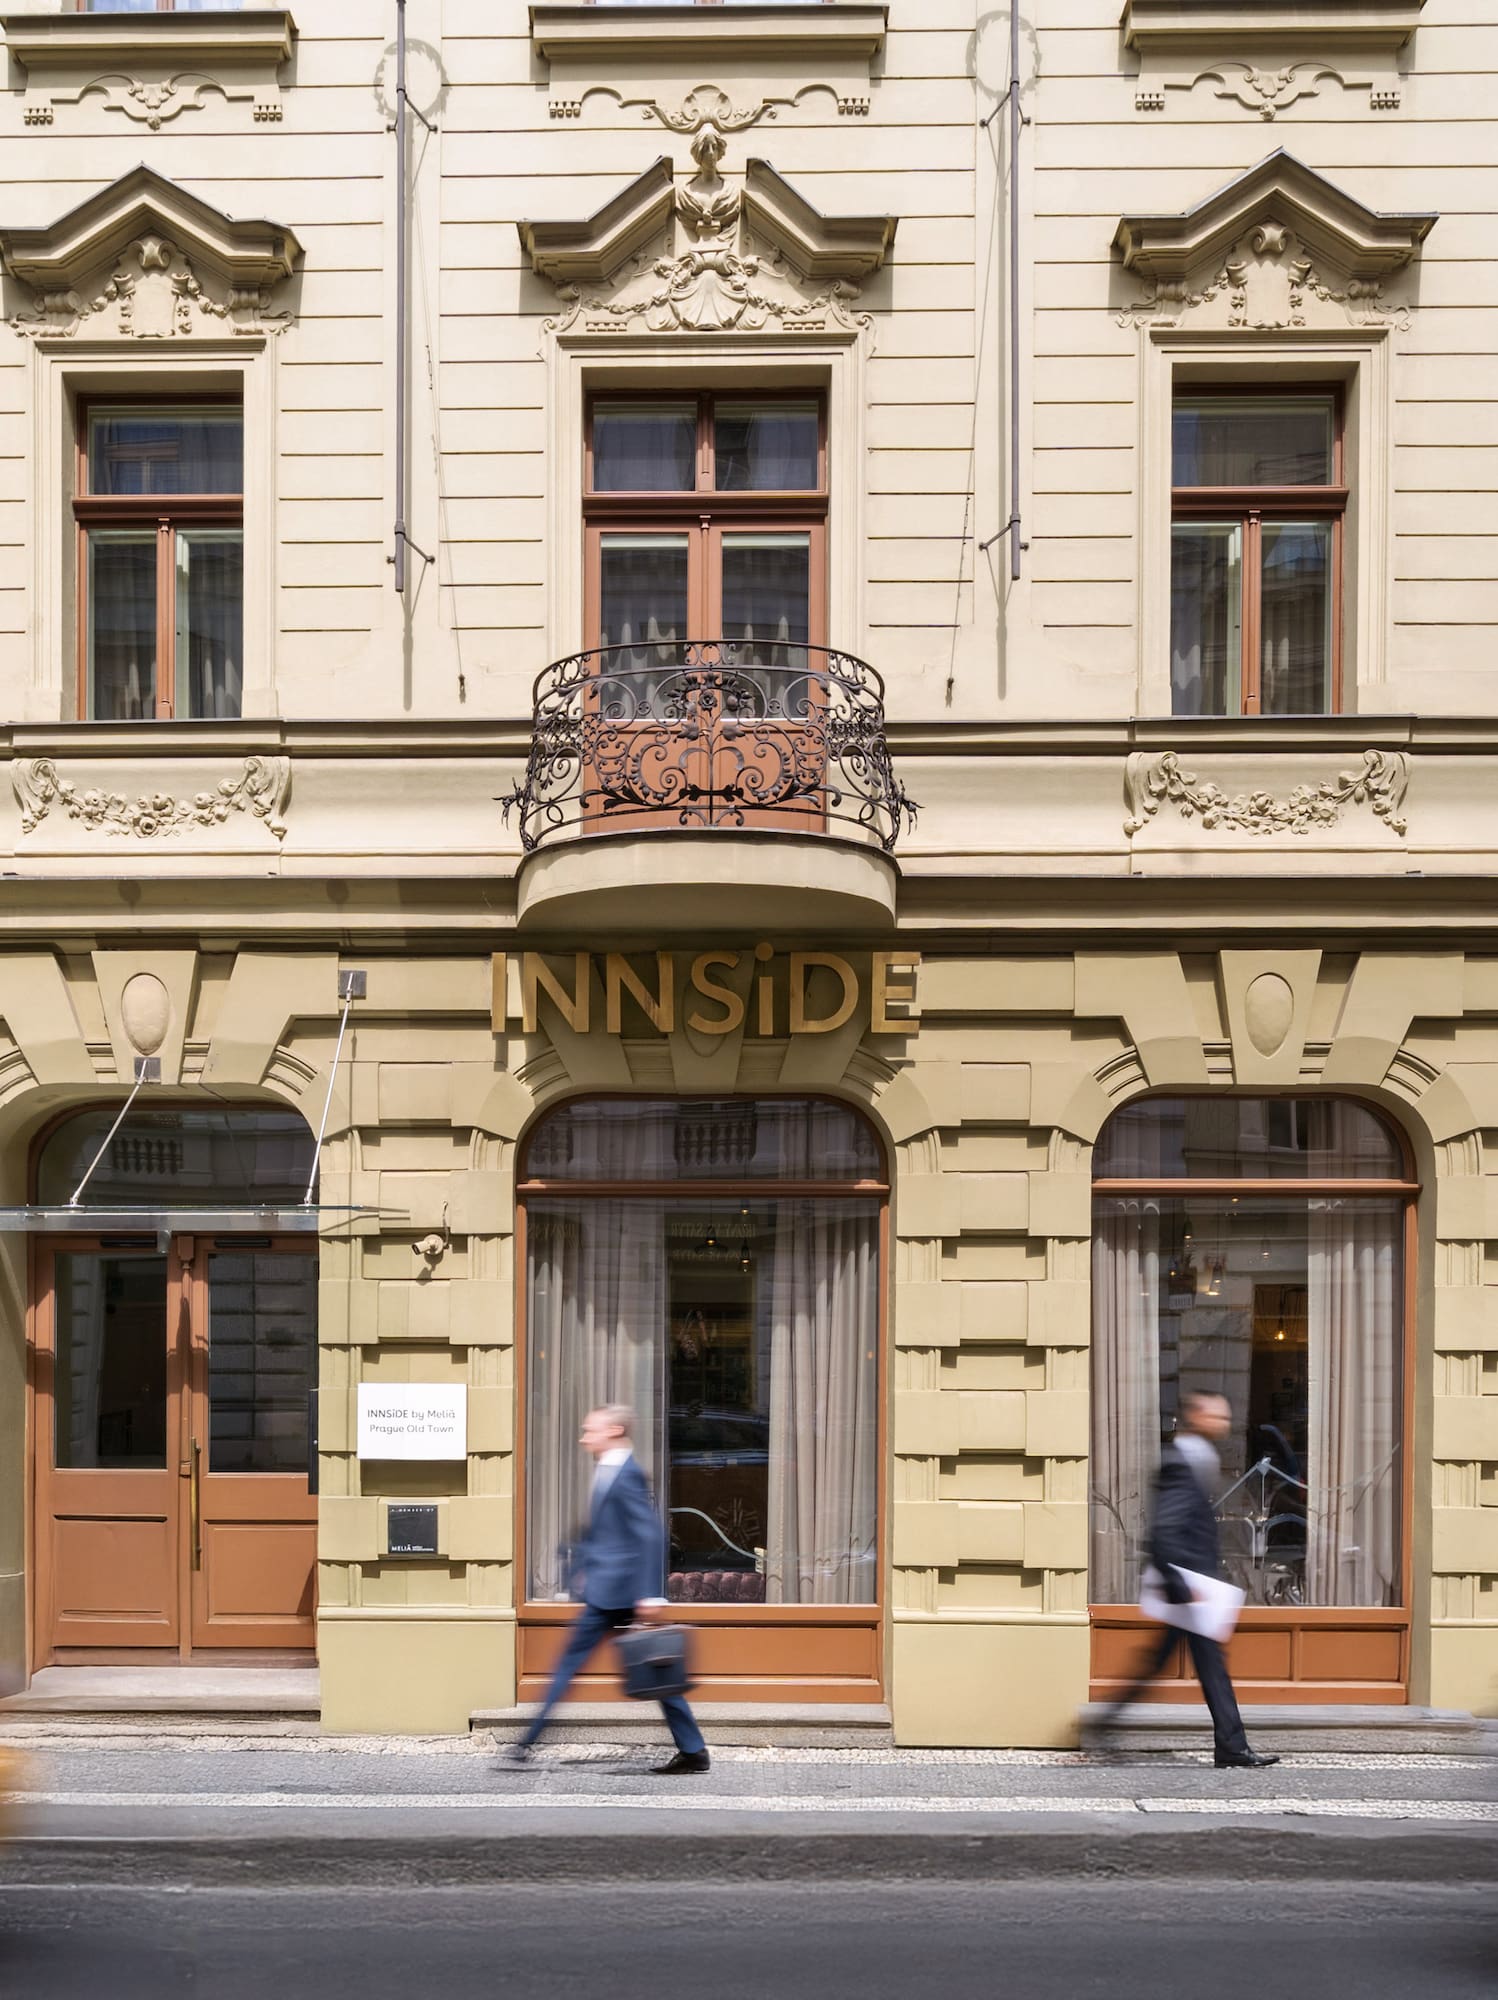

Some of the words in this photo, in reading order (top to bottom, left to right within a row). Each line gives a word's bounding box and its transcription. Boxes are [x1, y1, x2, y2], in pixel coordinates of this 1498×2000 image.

[490, 941, 921, 1036] INNSiDE
[367, 1408, 409, 1418] INNSiDE
[411, 1410, 425, 1421] by
[369, 1424, 405, 1435] Prague
[406, 1424, 425, 1433] Old
[427, 1424, 454, 1433] Town
